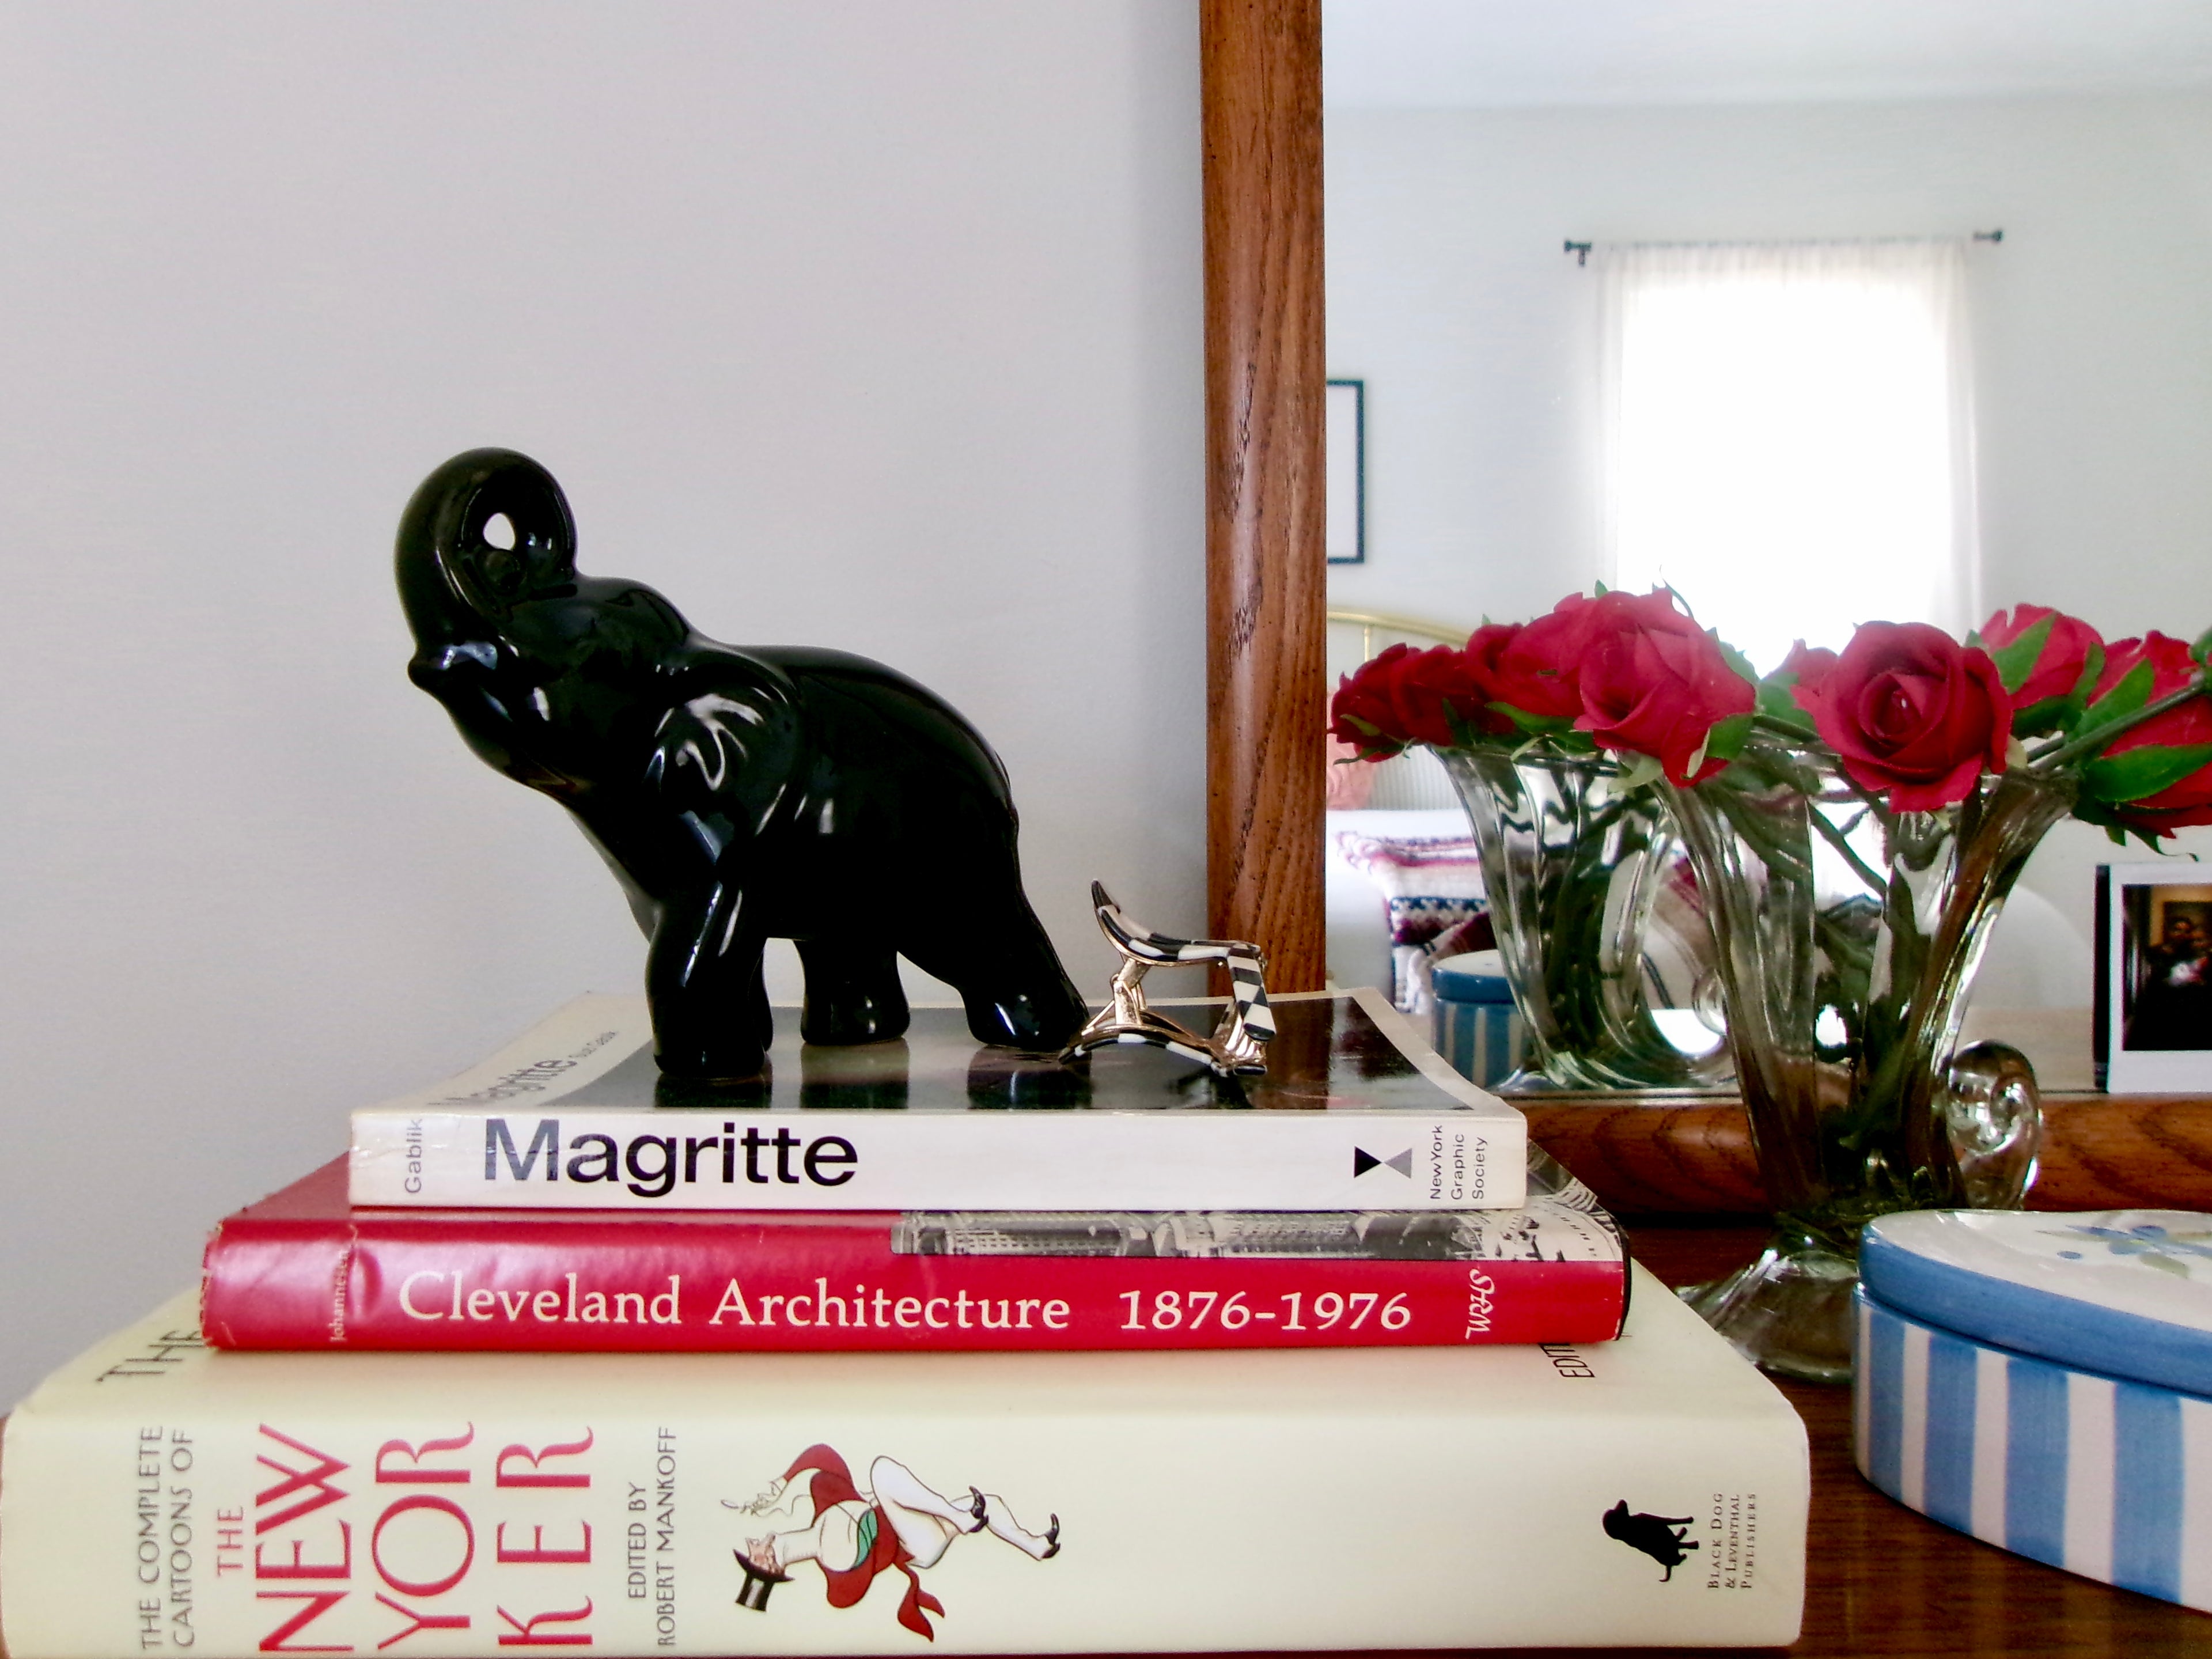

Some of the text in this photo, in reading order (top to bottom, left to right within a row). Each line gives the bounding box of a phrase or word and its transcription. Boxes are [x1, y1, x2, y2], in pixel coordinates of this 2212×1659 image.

[404, 1118, 422, 1194] Gablik
[485, 1118, 858, 1198] Magritte
[1450, 1133, 1467, 1200] Graphic
[1472, 1137, 1488, 1200] Society
[399, 1270, 1412, 1331] Cleveland Architecture 1876-1976
[1465, 1268, 1495, 1339] WRHS
[138, 1425, 164, 1650] THE COMPLETE
[170, 1430, 196, 1648] CARTOONS OF
[217, 1505, 244, 1577] THE
[255, 1423, 354, 1652] NEW
[372, 1421, 475, 1651] YOR
[495, 1426, 594, 1646] KER
[628, 1481, 647, 1600] EDITED BY
[656, 1426, 677, 1647] ROBERT MANKOFF
[1724, 1577, 1736, 1589] &
